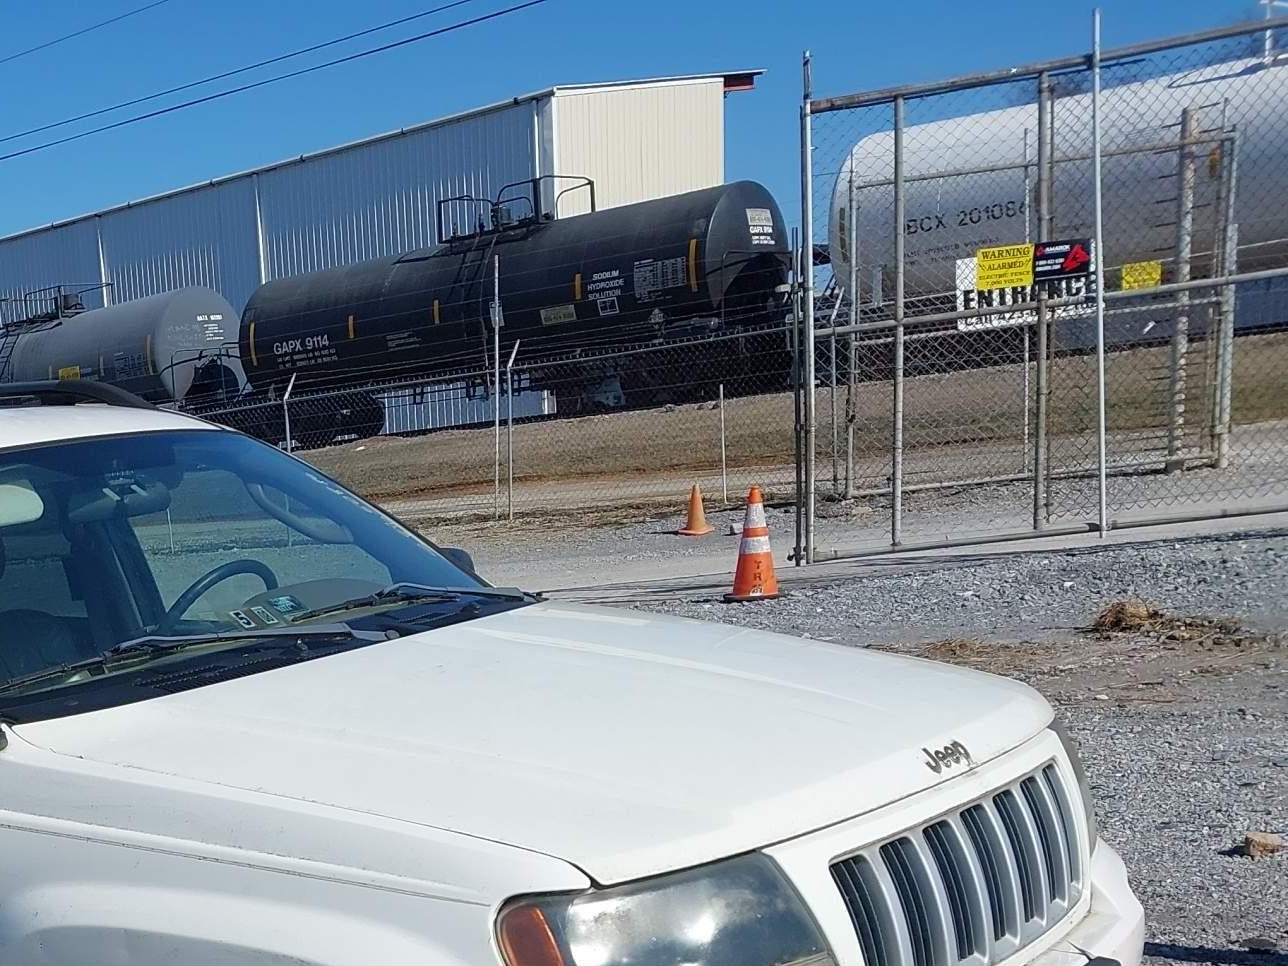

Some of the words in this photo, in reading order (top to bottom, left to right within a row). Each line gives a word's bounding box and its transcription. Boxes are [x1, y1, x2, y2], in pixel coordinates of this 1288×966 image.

[903, 213, 947, 235] BCX
[981, 246, 1030, 259] WARNING
[987, 261, 1024, 271] ALARMED
[592, 269, 620, 280] SODIUM
[587, 278, 624, 291] HYDROXIDE
[588, 288, 622, 301] SOLUTION
[273, 338, 303, 355] GAPX
[305, 334, 329, 350] 9114
[921, 740, 974, 774] Jeep
